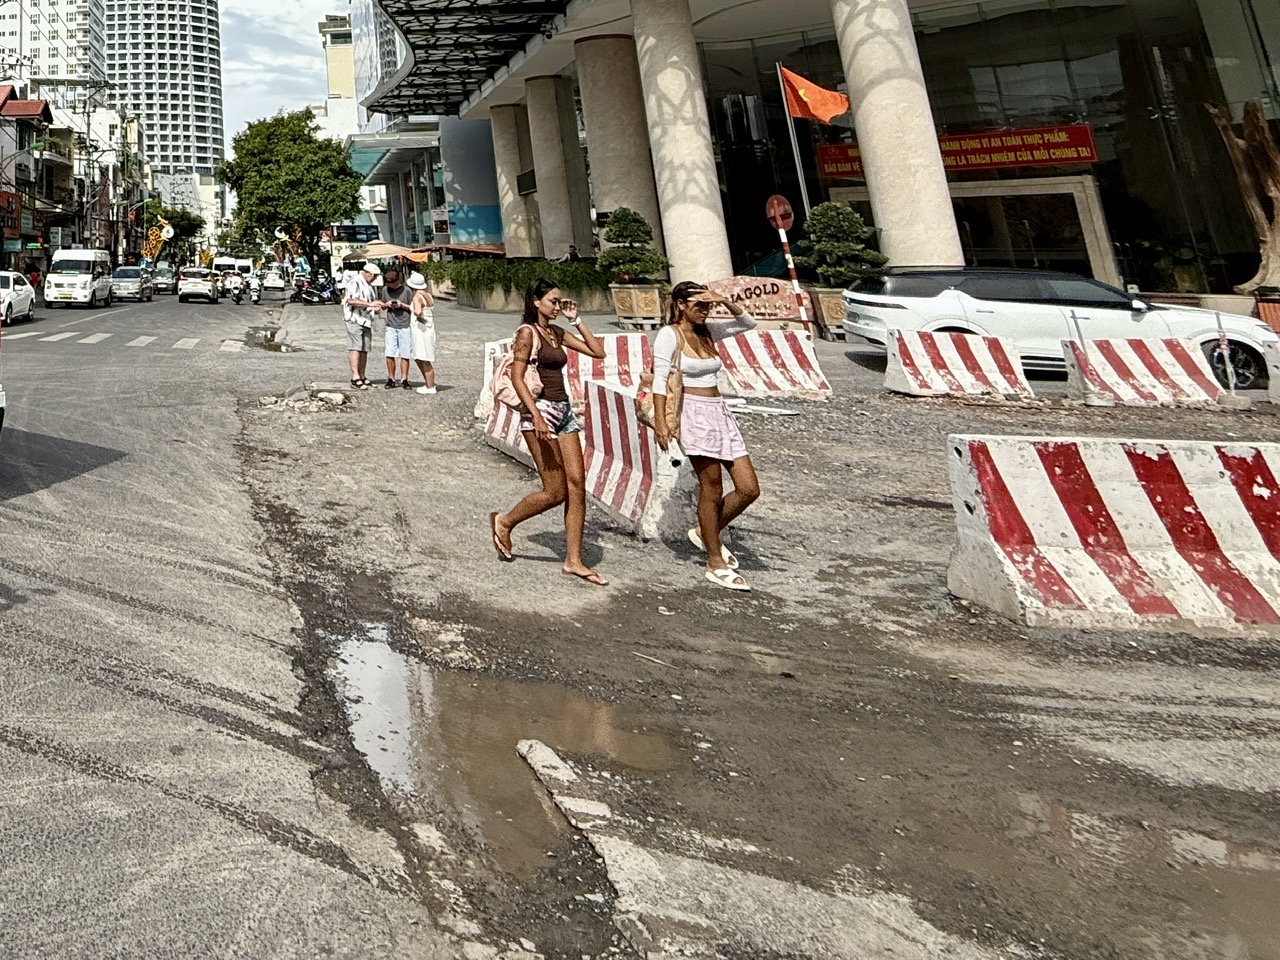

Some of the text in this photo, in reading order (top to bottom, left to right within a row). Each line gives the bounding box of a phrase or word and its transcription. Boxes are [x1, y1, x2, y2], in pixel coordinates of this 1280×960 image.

[991, 136, 1002, 147] AN
[957, 153, 967, 165] LÀ
[967, 150, 991, 165] TRÁCH
[991, 149, 1016, 164] NHIỆM
[1050, 145, 1078, 159] CHÚNG
[1078, 146, 1091, 157] TA!
[744, 282, 780, 300] GOLD
